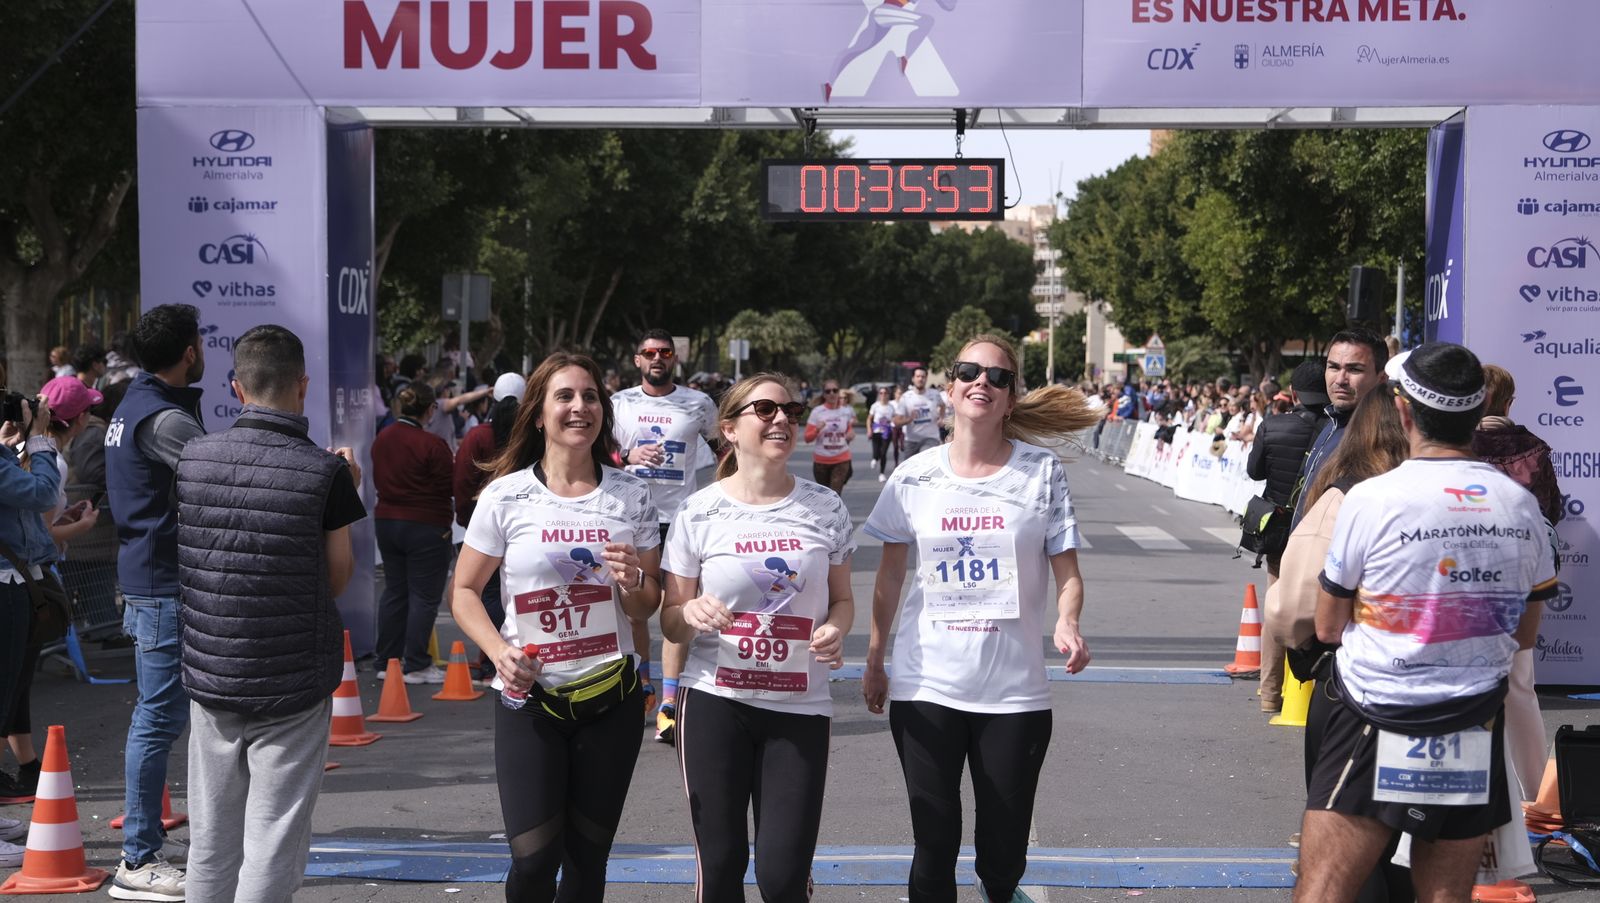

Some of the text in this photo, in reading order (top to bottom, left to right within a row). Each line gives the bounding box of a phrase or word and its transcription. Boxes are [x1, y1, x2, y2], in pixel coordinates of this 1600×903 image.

[1132, 0, 1467, 23] ES NUESTRA META.
[343, 0, 657, 70] MUJER
[1147, 44, 1199, 71] CDX
[1262, 42, 1325, 58] ALMERÍA
[1261, 59, 1294, 68] CIUDAD
[193, 156, 272, 167] HYUNDAI
[1524, 157, 1600, 168] HYUNDA
[203, 170, 264, 180] Almerialva
[1534, 171, 1599, 181] Almerialva
[801, 165, 993, 213] 00:35:53
[213, 197, 279, 214] cajamar
[198, 242, 254, 265] CASI
[1527, 245, 1587, 269] CASI
[218, 281, 276, 297] vithas
[338, 264, 369, 315] CDX
[1427, 268, 1450, 322] CDX
[1546, 286, 1600, 302] vitha
[638, 415, 673, 425] MUJER
[1537, 412, 1584, 427] Clece
[945, 507, 979, 515] CARRERA
[980, 506, 990, 514] DE
[941, 515, 1005, 532] MUJER
[541, 528, 611, 543] MUJER
[736, 530, 773, 540] CARRERA
[734, 538, 804, 554] MUJER
[1442, 539, 1468, 550] Costa
[935, 557, 1000, 583] 1181
[1450, 567, 1502, 583] soltec
[962, 581, 977, 590] LSG
[527, 596, 551, 605] MUJER
[539, 604, 591, 634] 917
[732, 621, 753, 629] MUJER
[558, 630, 580, 639] GEMA
[737, 637, 789, 662] 999
[1536, 634, 1583, 661] Galatea
[1406, 734, 1461, 760] 261
[1430, 760, 1444, 768] EPI
